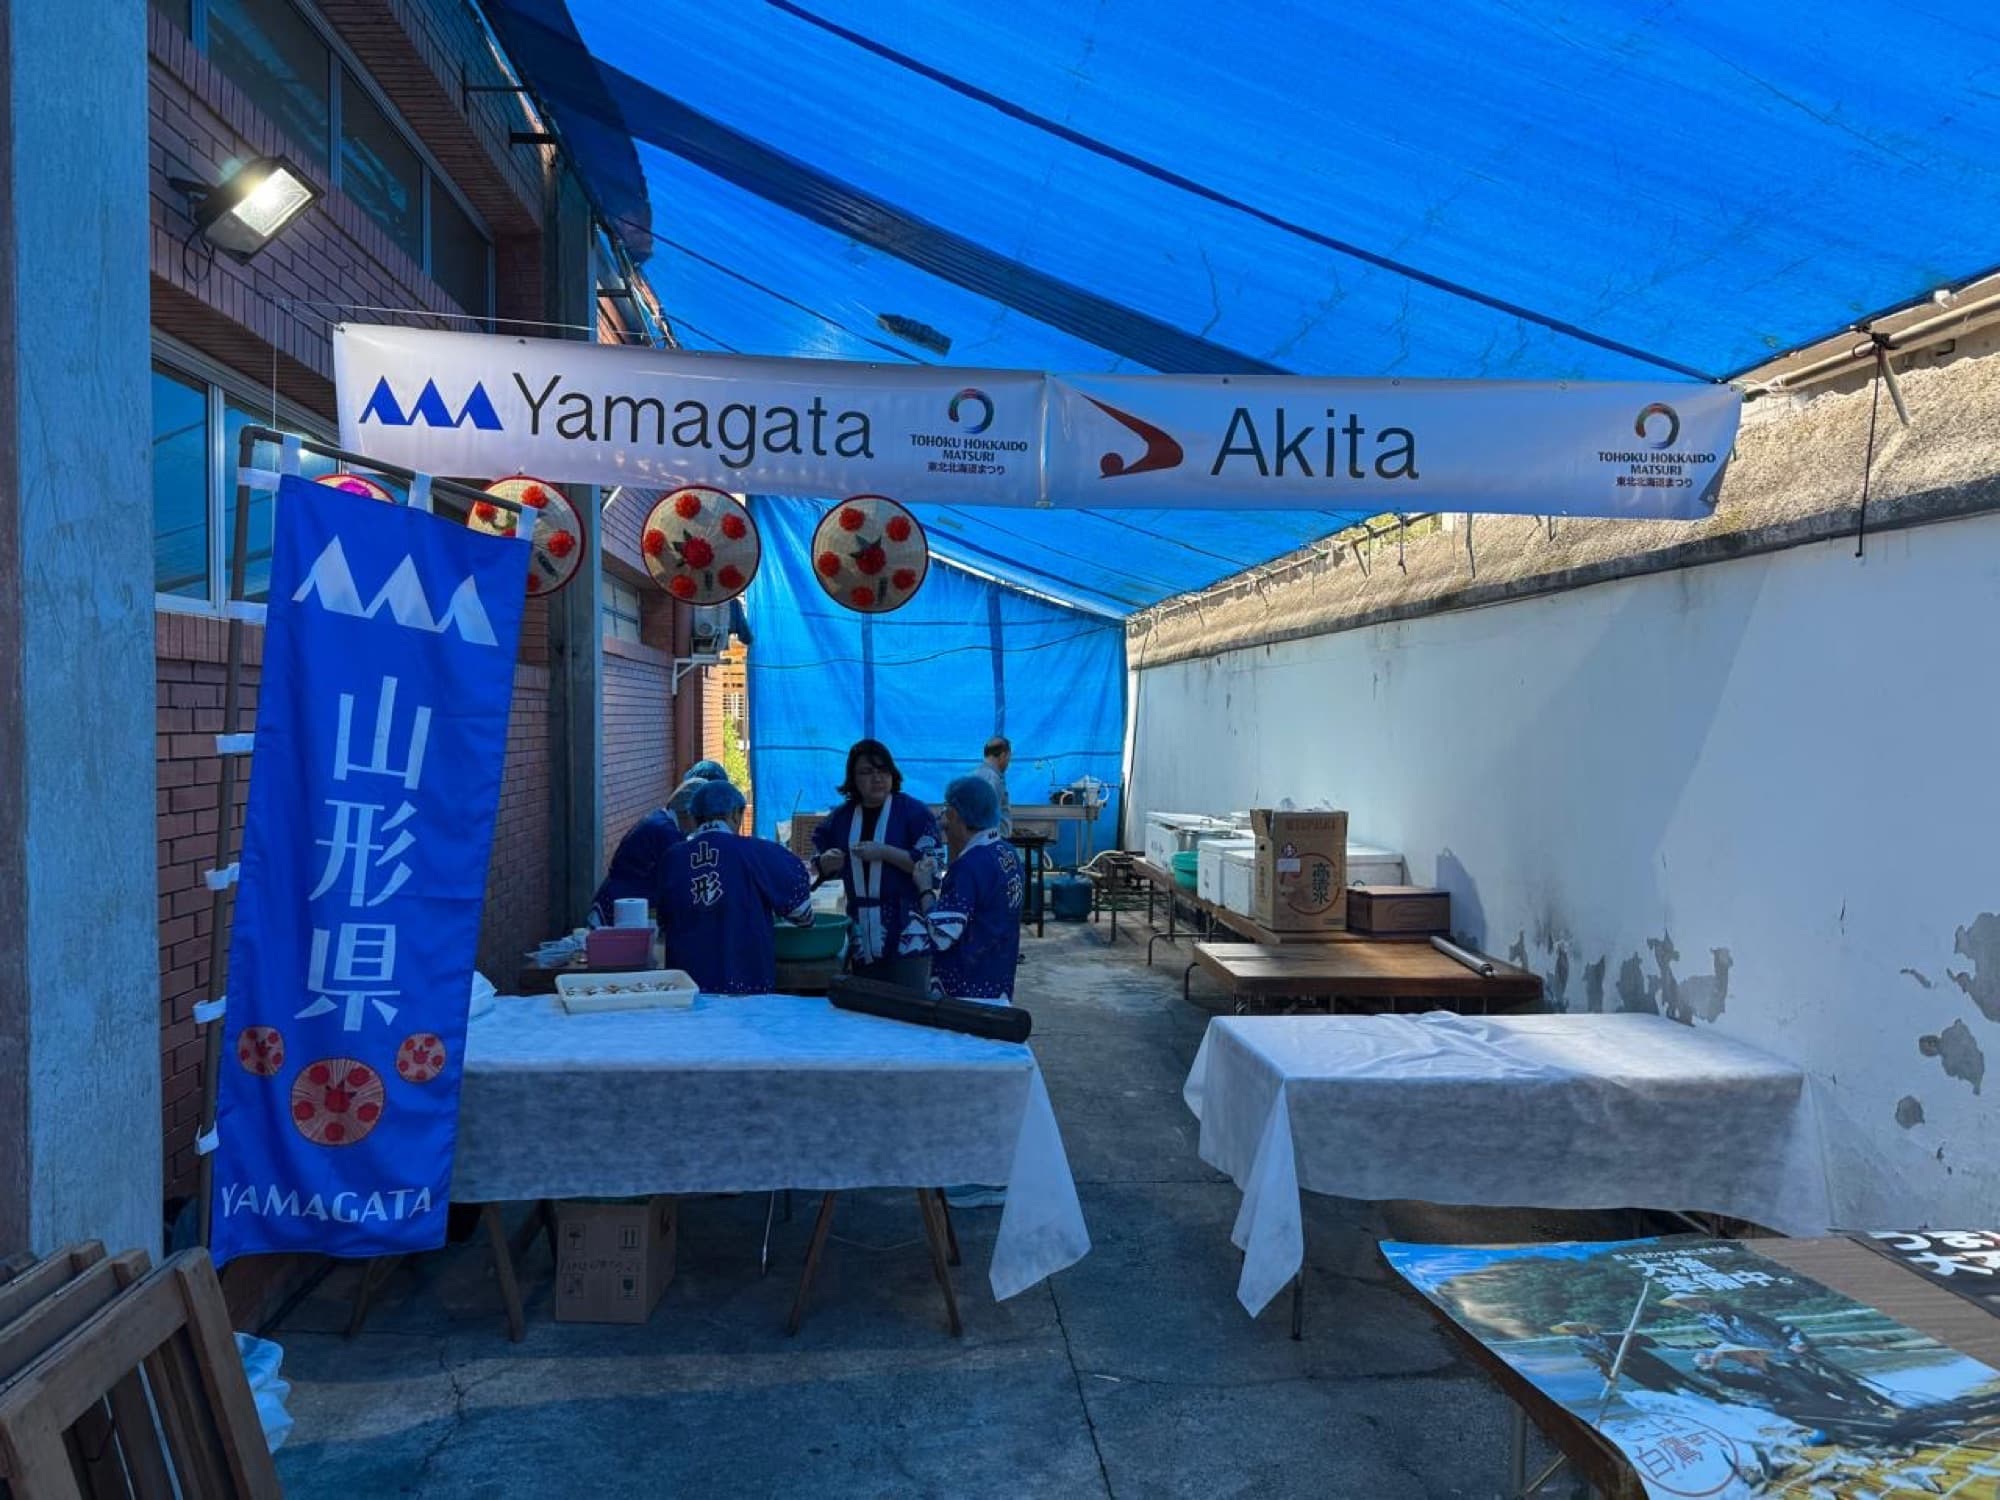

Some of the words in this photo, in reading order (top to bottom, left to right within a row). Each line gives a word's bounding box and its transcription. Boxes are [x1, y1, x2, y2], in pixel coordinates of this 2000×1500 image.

[512, 372, 875, 469] Yamagata
[911, 434, 961, 449] TOHOKU
[964, 438, 1028, 453] HOKKAIDO
[1210, 406, 1419, 481] Akita
[943, 450, 995, 463] MATSURI
[1598, 451, 1648, 464] TOHOKU
[1651, 452, 1717, 464] HOKKAIDO
[927, 461, 1006, 476] 東北北海道まつり
[1631, 463, 1682, 476] MATSURI
[1616, 476, 1693, 489] 東北北海道まつり
[294, 675, 432, 1033] 山形県
[690, 841, 723, 906] 山形
[221, 1182, 432, 1224] YAMAGATA
